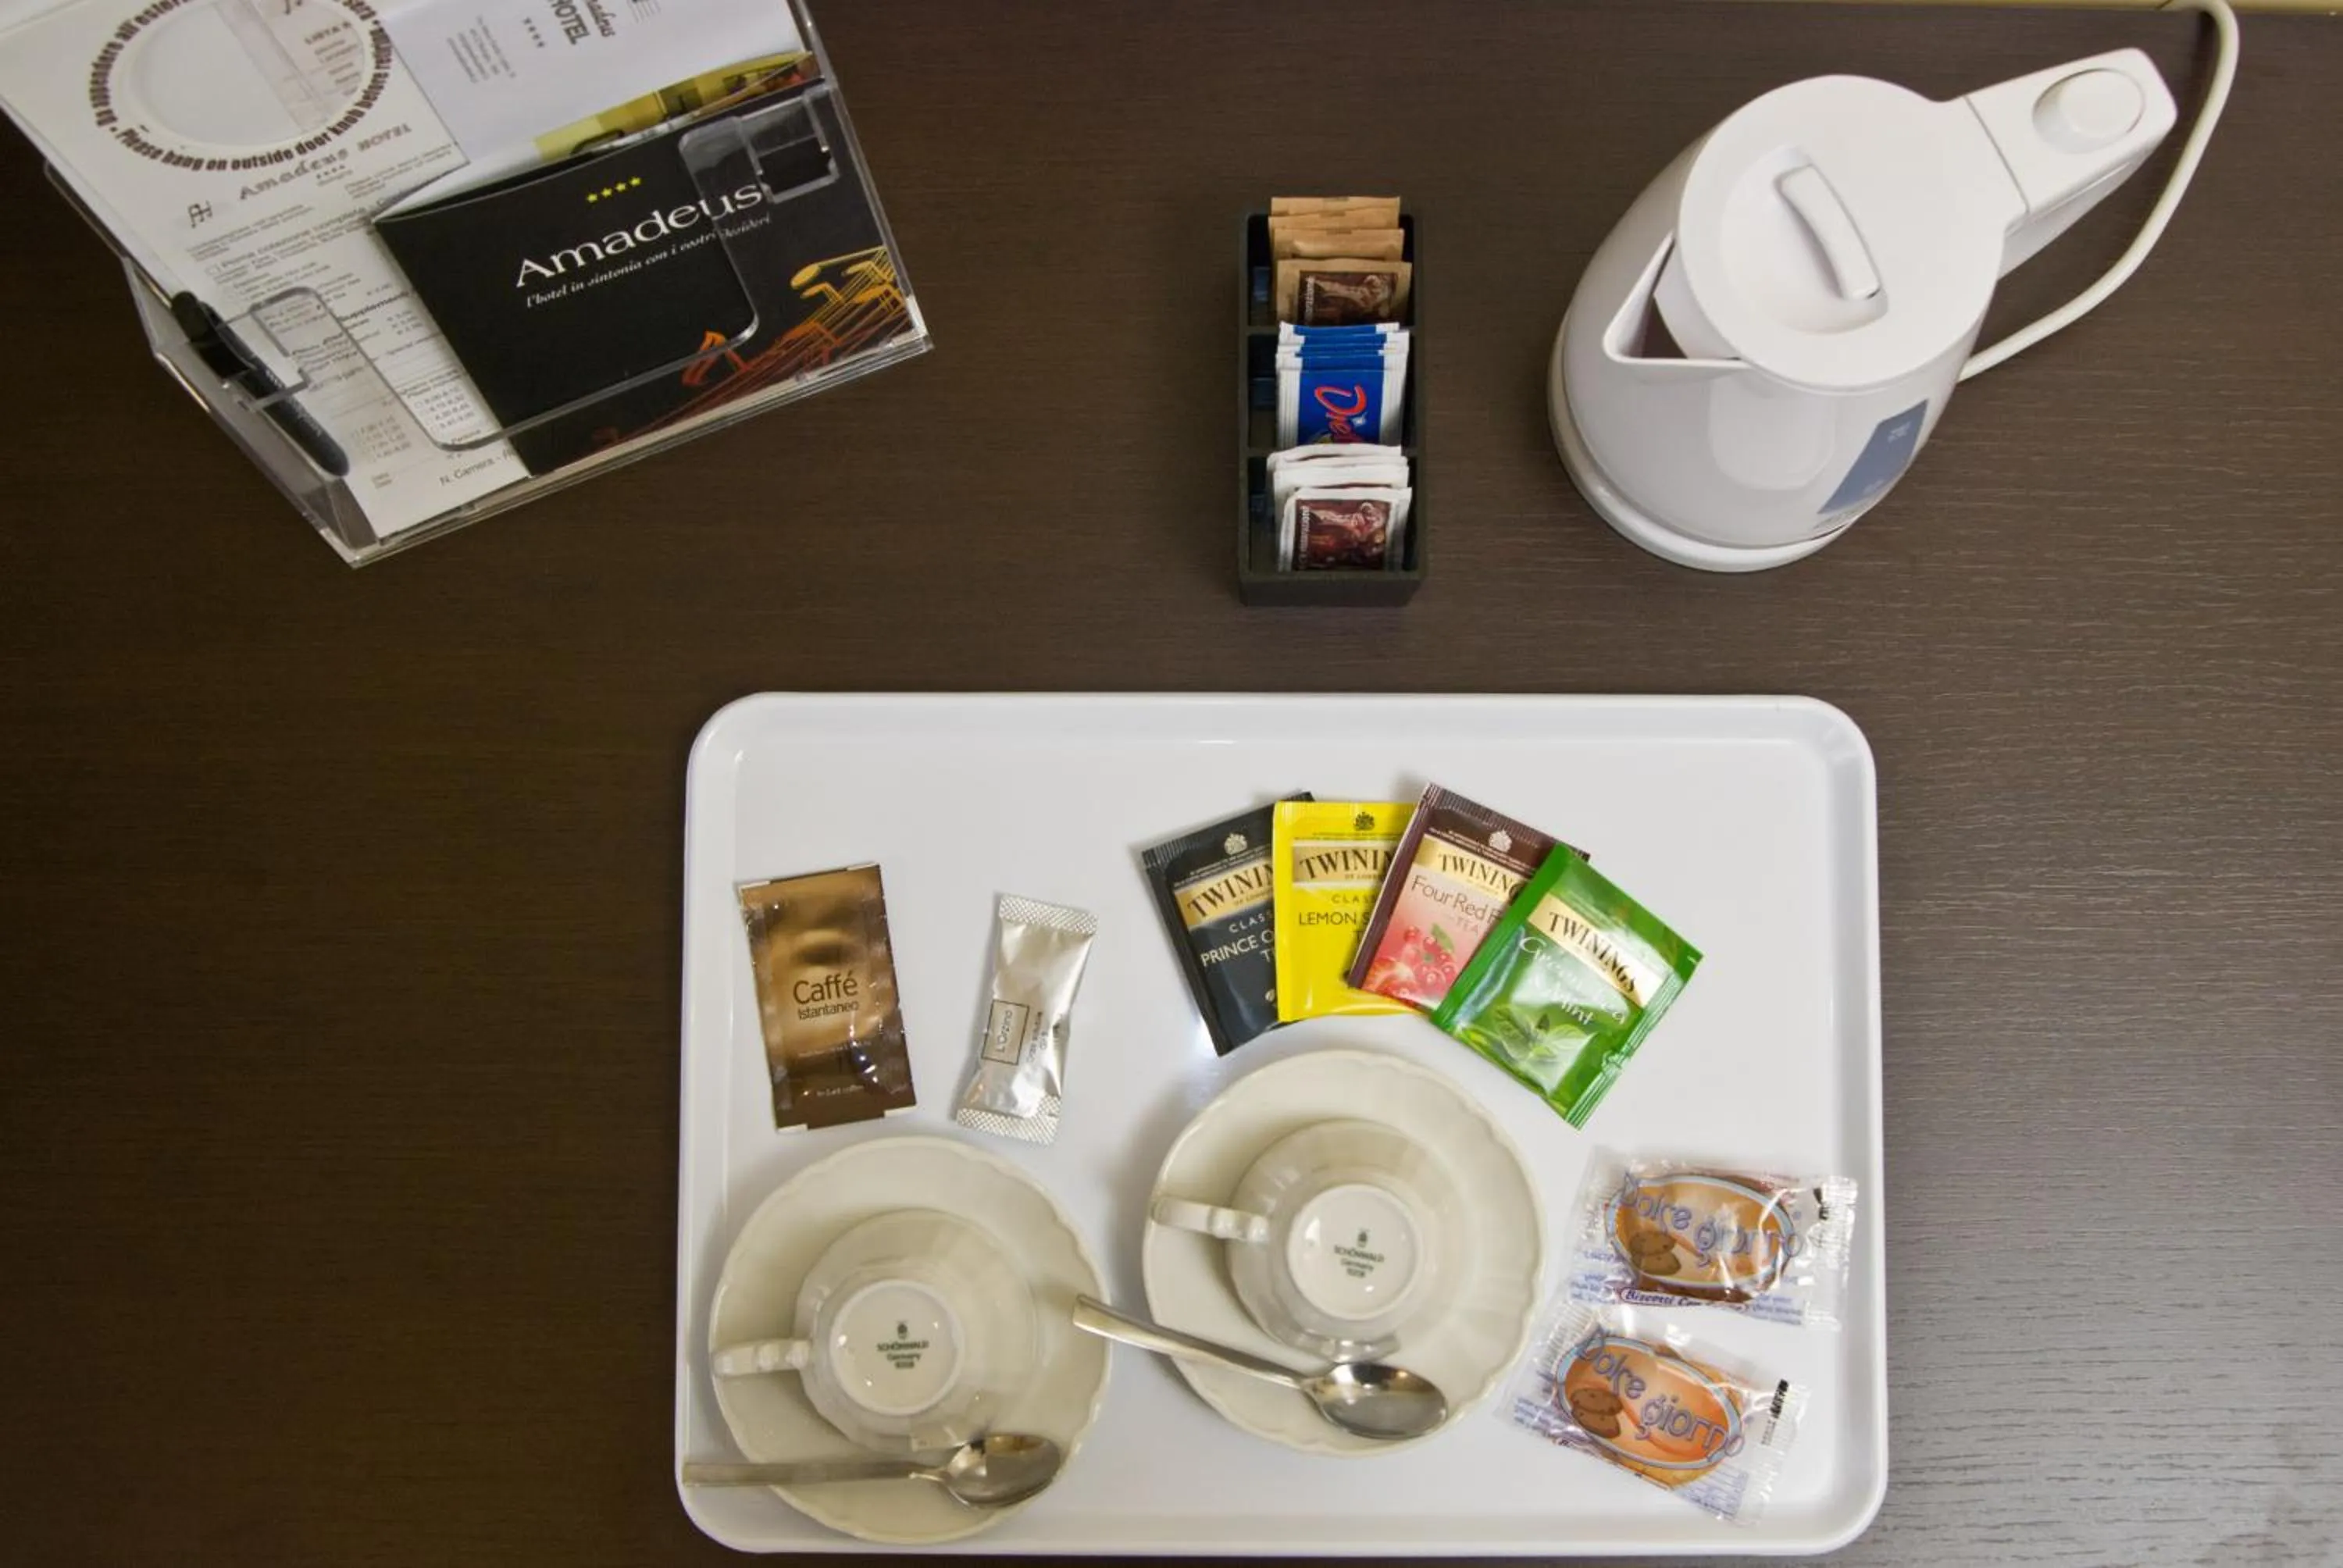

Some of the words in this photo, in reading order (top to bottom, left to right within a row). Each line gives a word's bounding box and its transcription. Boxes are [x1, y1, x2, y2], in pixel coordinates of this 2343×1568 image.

[161, 150, 205, 171] hang
[205, 159, 228, 170] on
[231, 148, 294, 171] outside
[294, 132, 332, 156] door
[515, 183, 765, 288] Amadeus
[569, 277, 585, 294] in
[644, 251, 669, 268] con
[1411, 873, 1454, 905] Four
[1453, 892, 1489, 921] Red
[1299, 911, 1357, 926] LEMON
[1200, 934, 1259, 967] PRINCE
[1548, 911, 1638, 993] TWININGS
[792, 969, 860, 1006] Caffé
[797, 999, 860, 1021] Istantaneo
[1633, 1394, 1746, 1463] giorno
